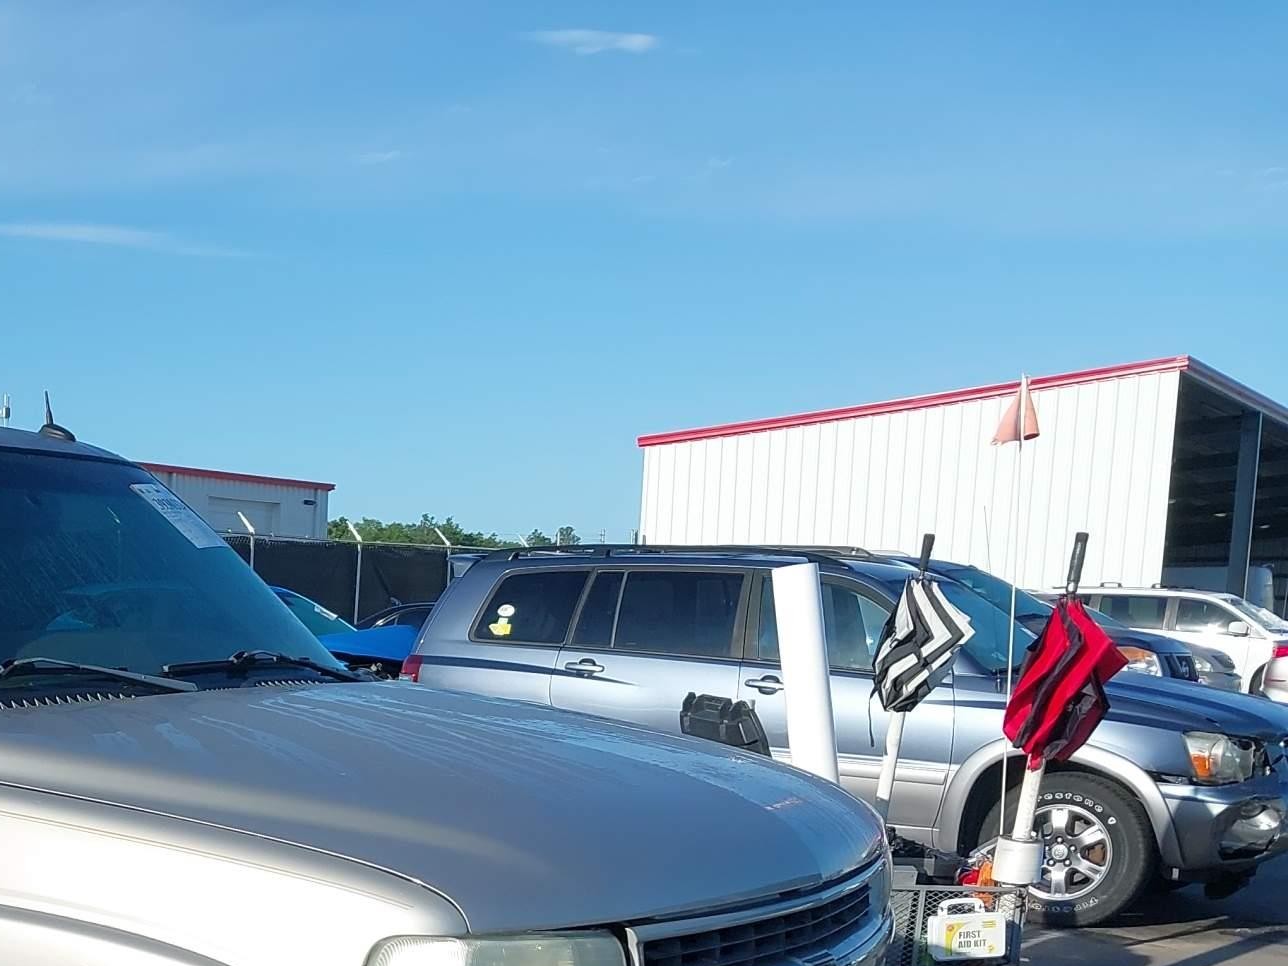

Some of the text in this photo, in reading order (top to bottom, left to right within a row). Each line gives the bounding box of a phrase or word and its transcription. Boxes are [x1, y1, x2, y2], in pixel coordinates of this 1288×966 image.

[958, 930, 981, 940] FIRST
[958, 939, 987, 949] AID KIT
